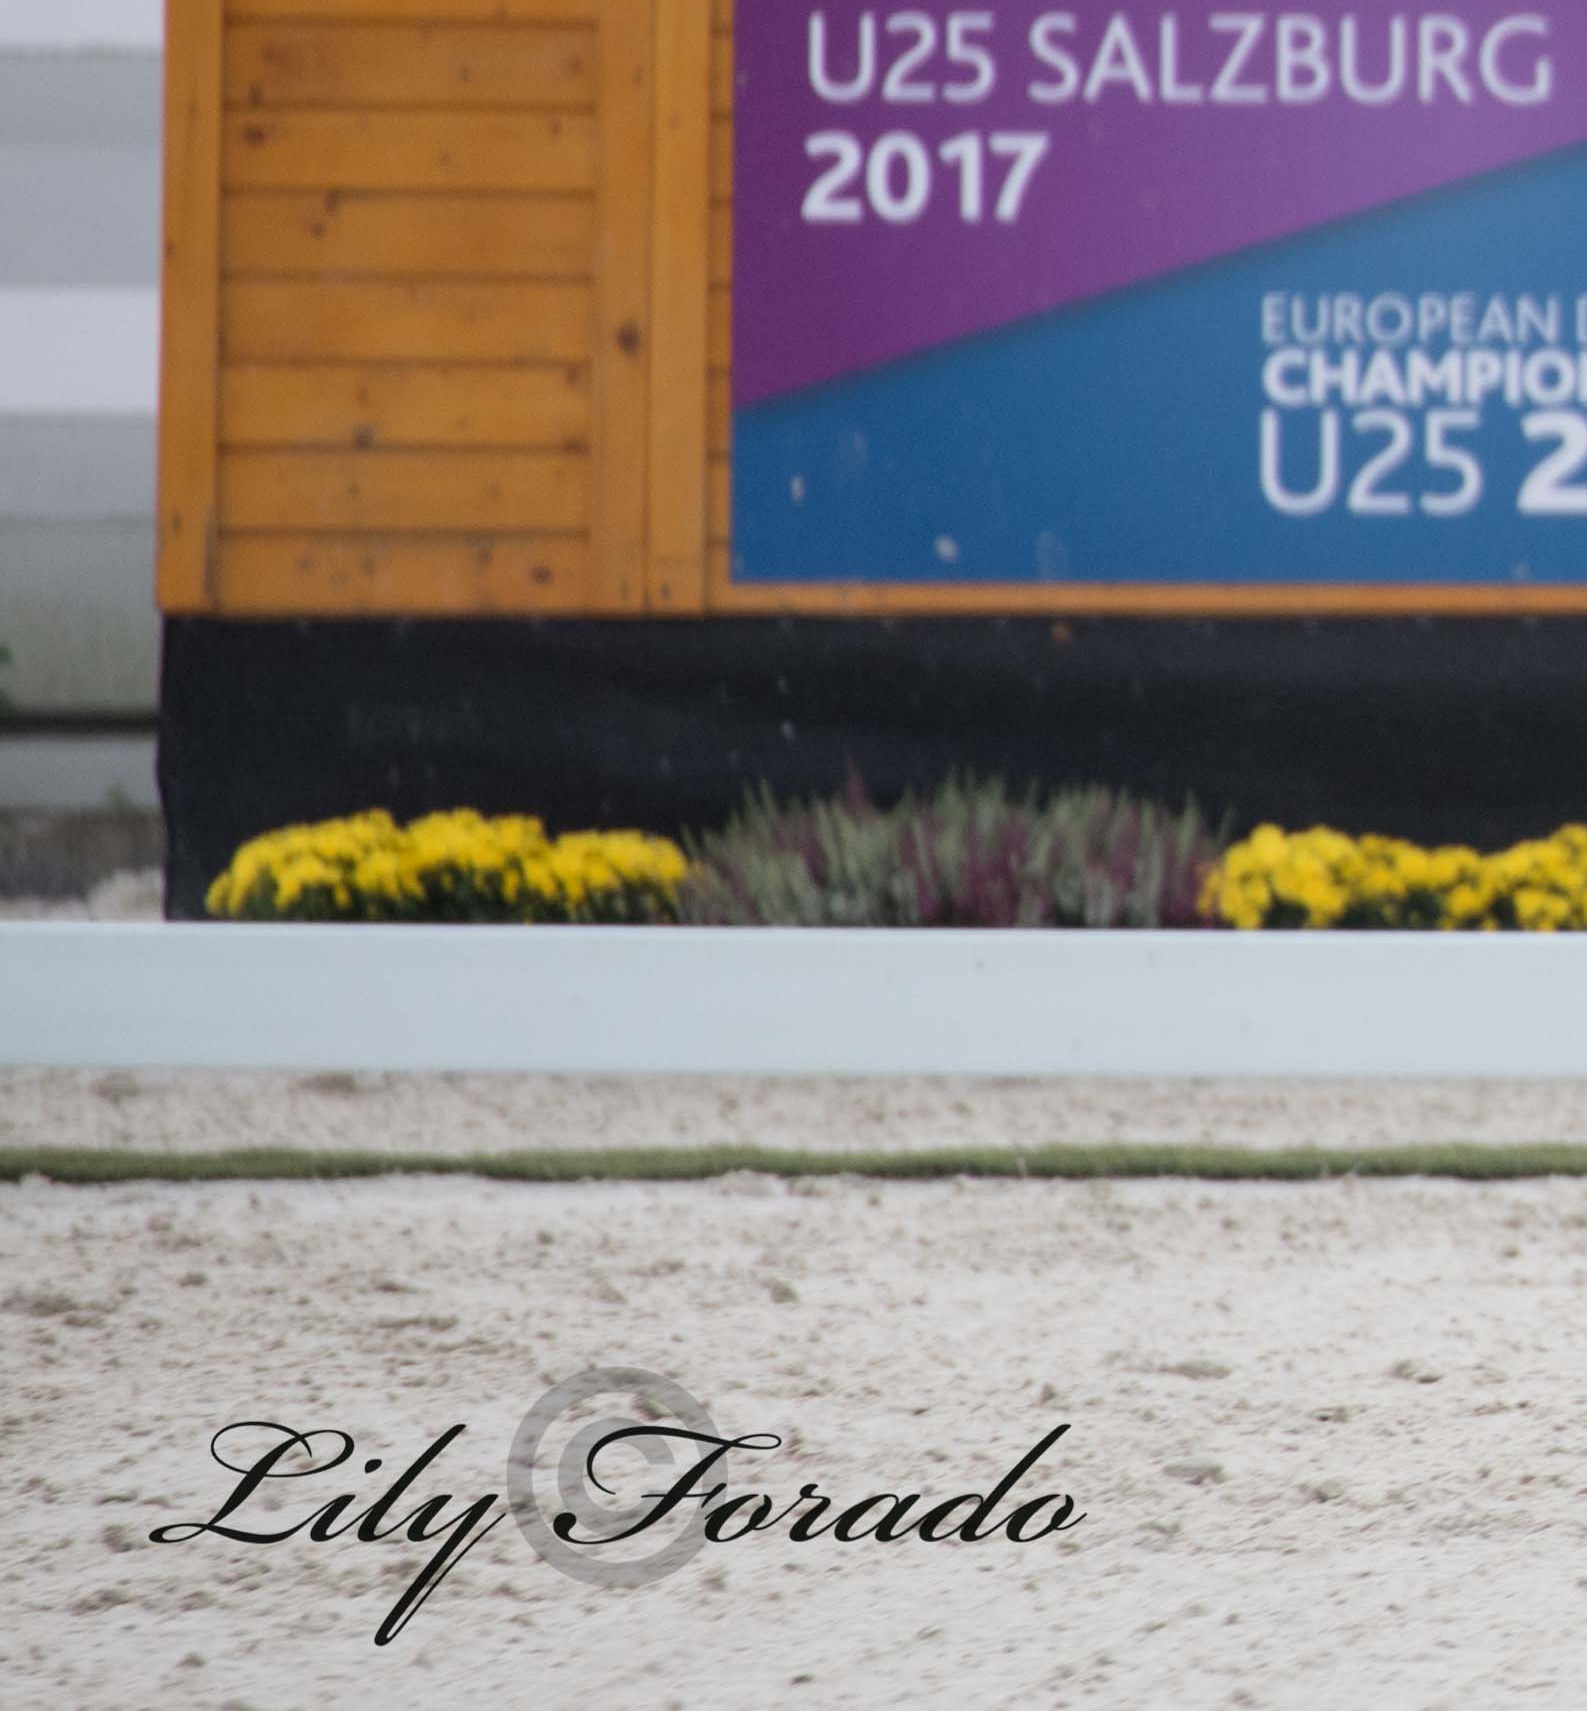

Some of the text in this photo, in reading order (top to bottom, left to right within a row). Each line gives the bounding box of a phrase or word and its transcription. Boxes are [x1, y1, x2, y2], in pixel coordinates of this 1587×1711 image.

[807, 10, 1555, 107] U25 SALZBURG
[800, 130, 1050, 223] 2017
[1260, 292, 1560, 344] EUROPEAN
[1259, 407, 1483, 516] U25
